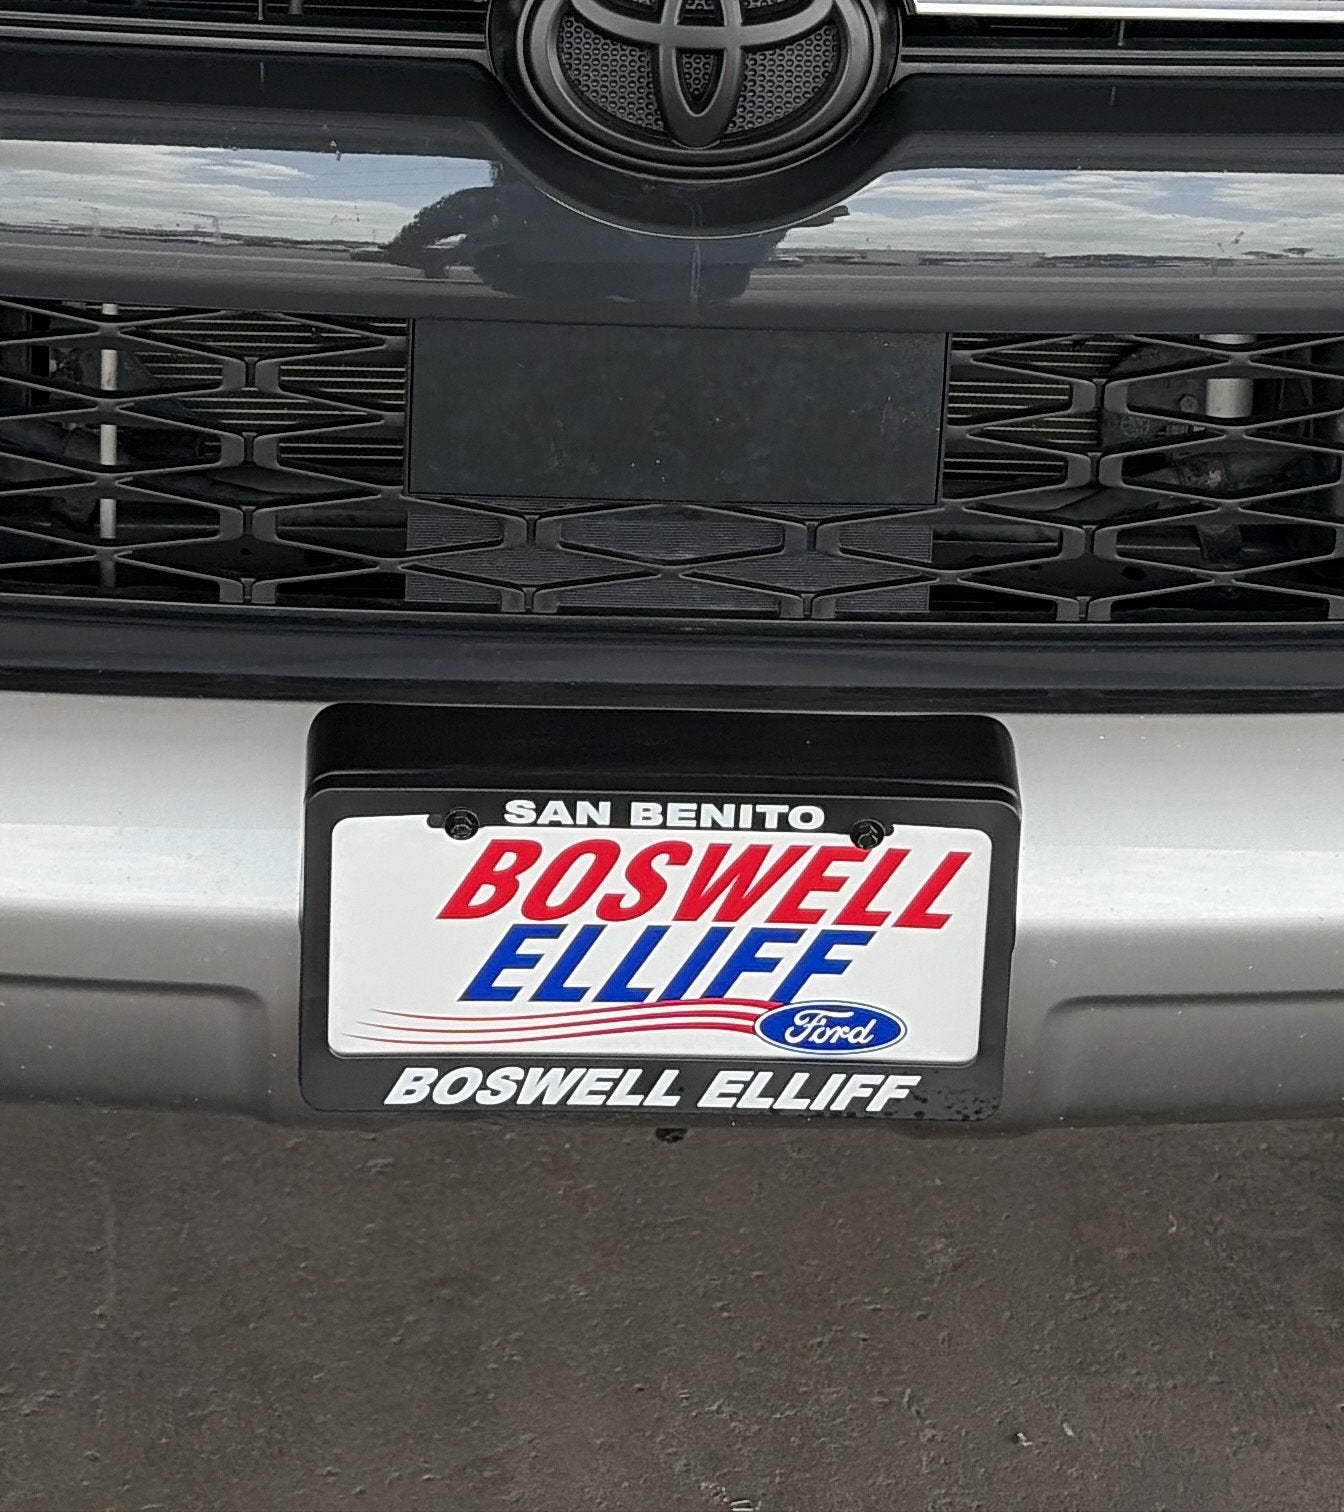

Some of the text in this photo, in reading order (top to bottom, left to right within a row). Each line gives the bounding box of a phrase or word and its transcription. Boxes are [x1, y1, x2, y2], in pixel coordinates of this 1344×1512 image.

[504, 799, 825, 831] SAN BENITO
[436, 838, 972, 929] BOSWELL
[457, 924, 877, 1005] ELLIFF
[784, 1015, 875, 1046] Ford
[384, 1066, 921, 1112] BOSWELL ELLIFF
